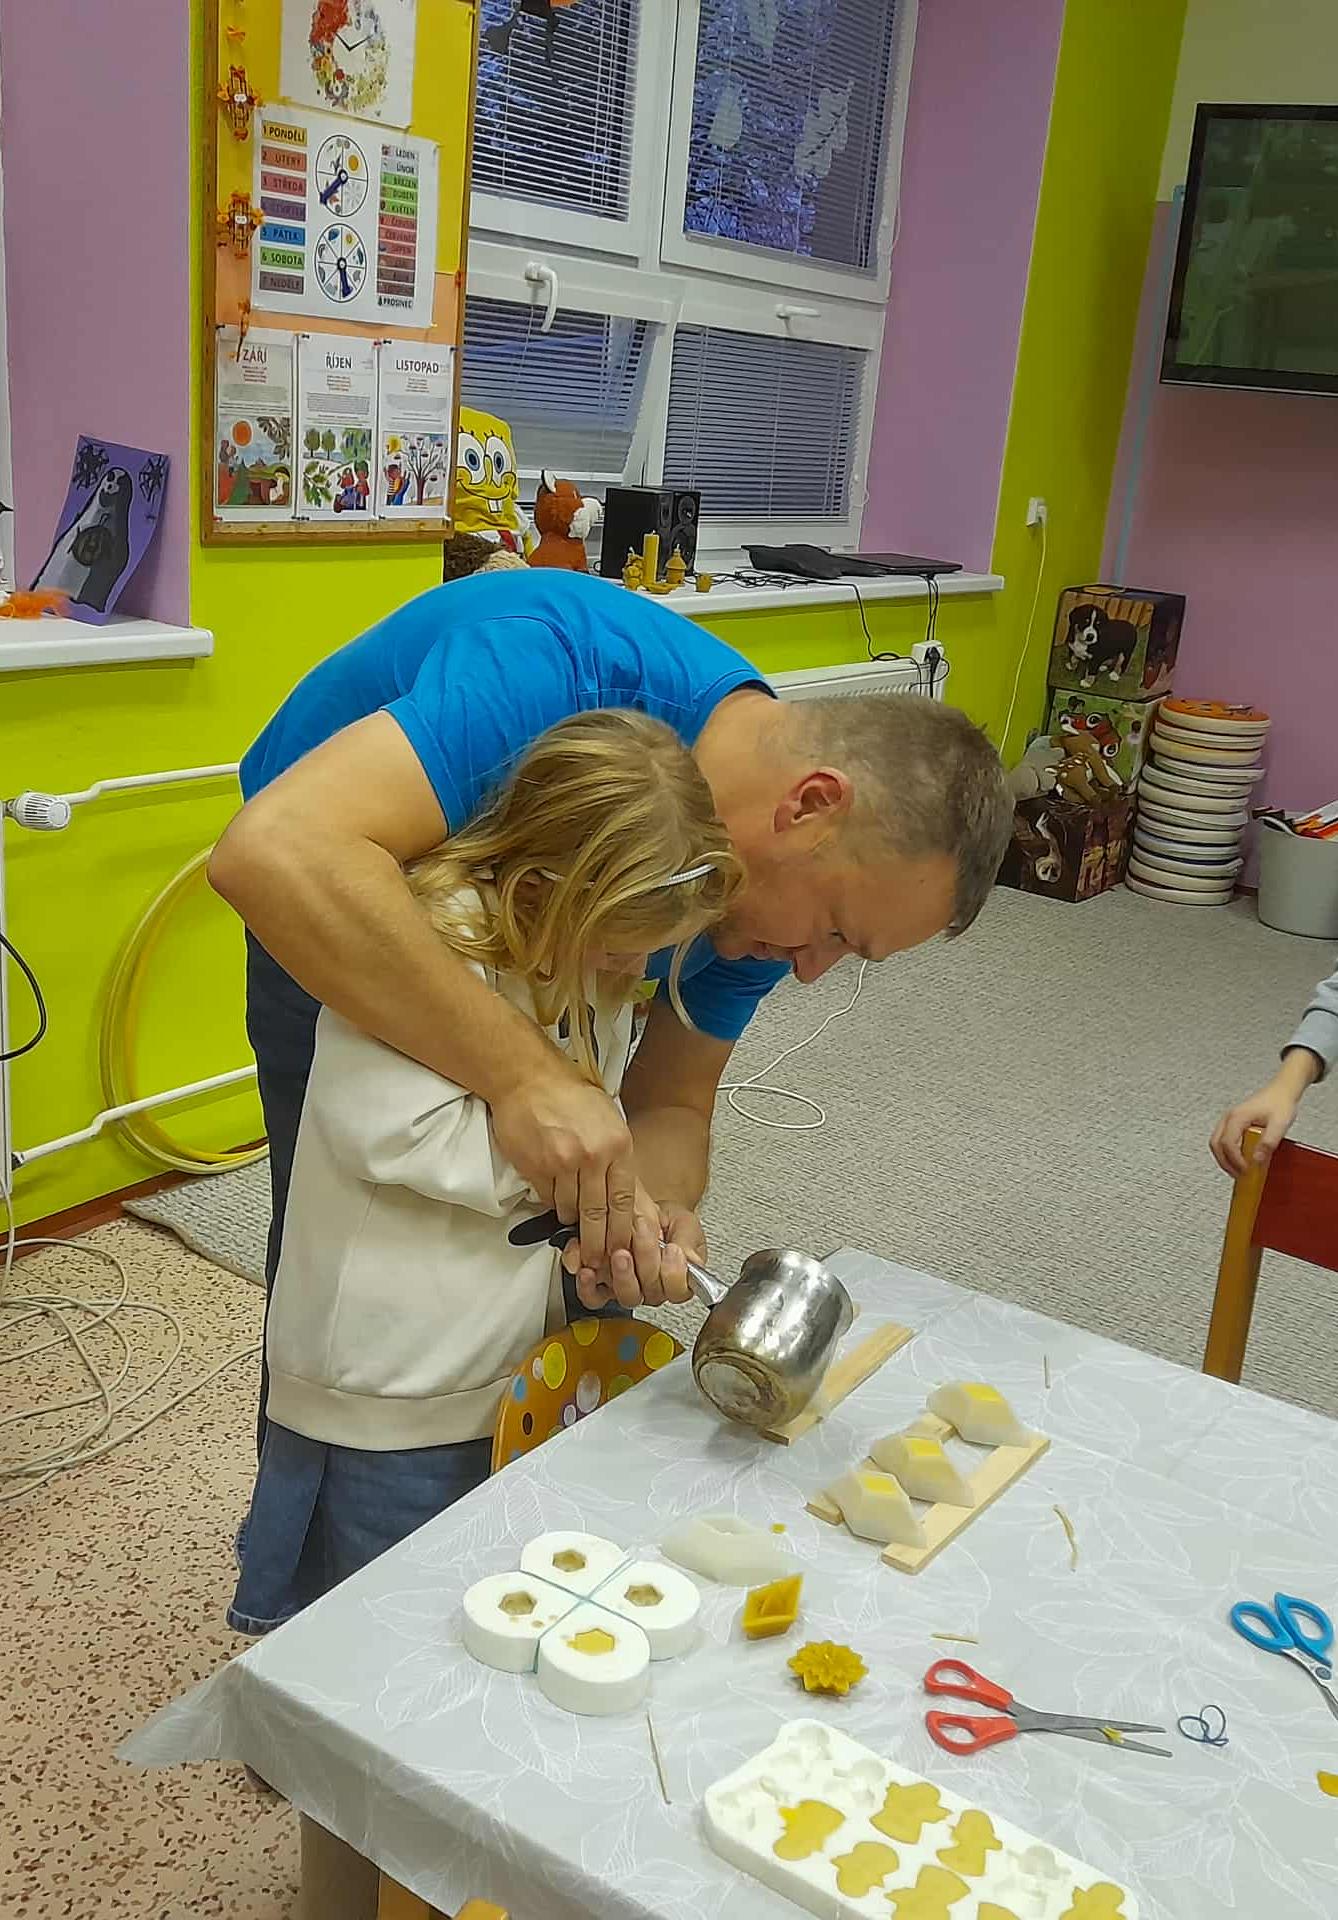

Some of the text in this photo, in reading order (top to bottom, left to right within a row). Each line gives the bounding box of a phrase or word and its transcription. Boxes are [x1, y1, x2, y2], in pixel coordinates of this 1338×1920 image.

[271, 252, 303, 265] SOBOTA
[243, 345, 267, 364] ZÁŘÍ
[326, 352, 352, 369] ŘÍJEN
[396, 359, 439, 375] LISTOPAD
